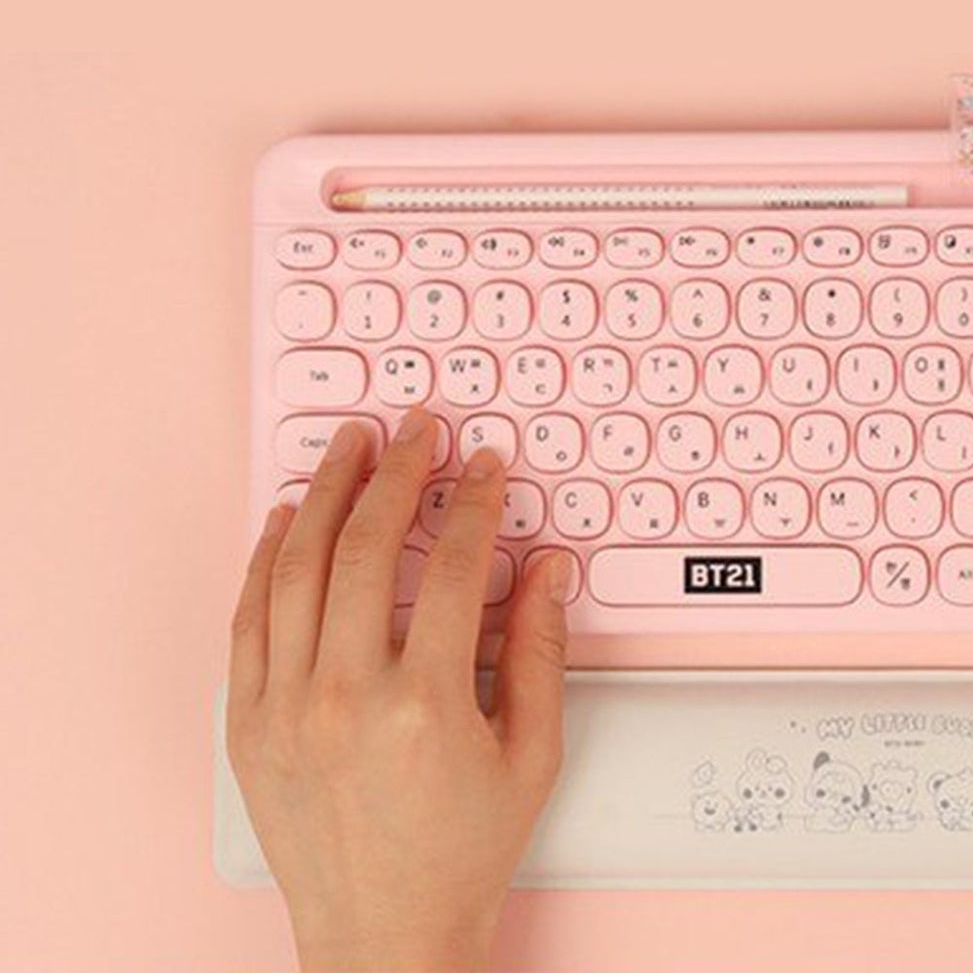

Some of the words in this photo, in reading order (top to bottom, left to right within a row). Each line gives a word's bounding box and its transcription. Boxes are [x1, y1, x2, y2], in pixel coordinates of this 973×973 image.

[293, 241, 314, 254] Esc
[429, 313, 440, 329] 2
[561, 314, 571, 327] 4
[627, 313, 637, 328] 5
[692, 313, 703, 328] 6
[760, 312, 770, 327] 7
[825, 312, 836, 328] 8
[892, 312, 904, 327] 9
[958, 311, 970, 327] 0
[385, 358, 399, 376] Q
[449, 359, 467, 374] W
[517, 356, 527, 375] E
[583, 357, 596, 372] R
[651, 356, 661, 372] T
[717, 358, 729, 373] Y
[782, 358, 796, 374] U
[913, 356, 929, 374] O
[310, 370, 330, 382] Tab
[471, 426, 484, 444] S
[535, 425, 550, 443] D
[602, 424, 613, 440] F
[667, 424, 682, 443] G
[735, 426, 749, 440] H
[803, 426, 814, 442] J
[869, 425, 881, 439] K
[936, 425, 947, 442] L
[432, 491, 444, 509] Z
[564, 491, 578, 509] C
[630, 492, 644, 507] V
[697, 491, 710, 509] B
[763, 492, 777, 507] N
[830, 492, 846, 505] M
[690, 563, 756, 587] BT21
